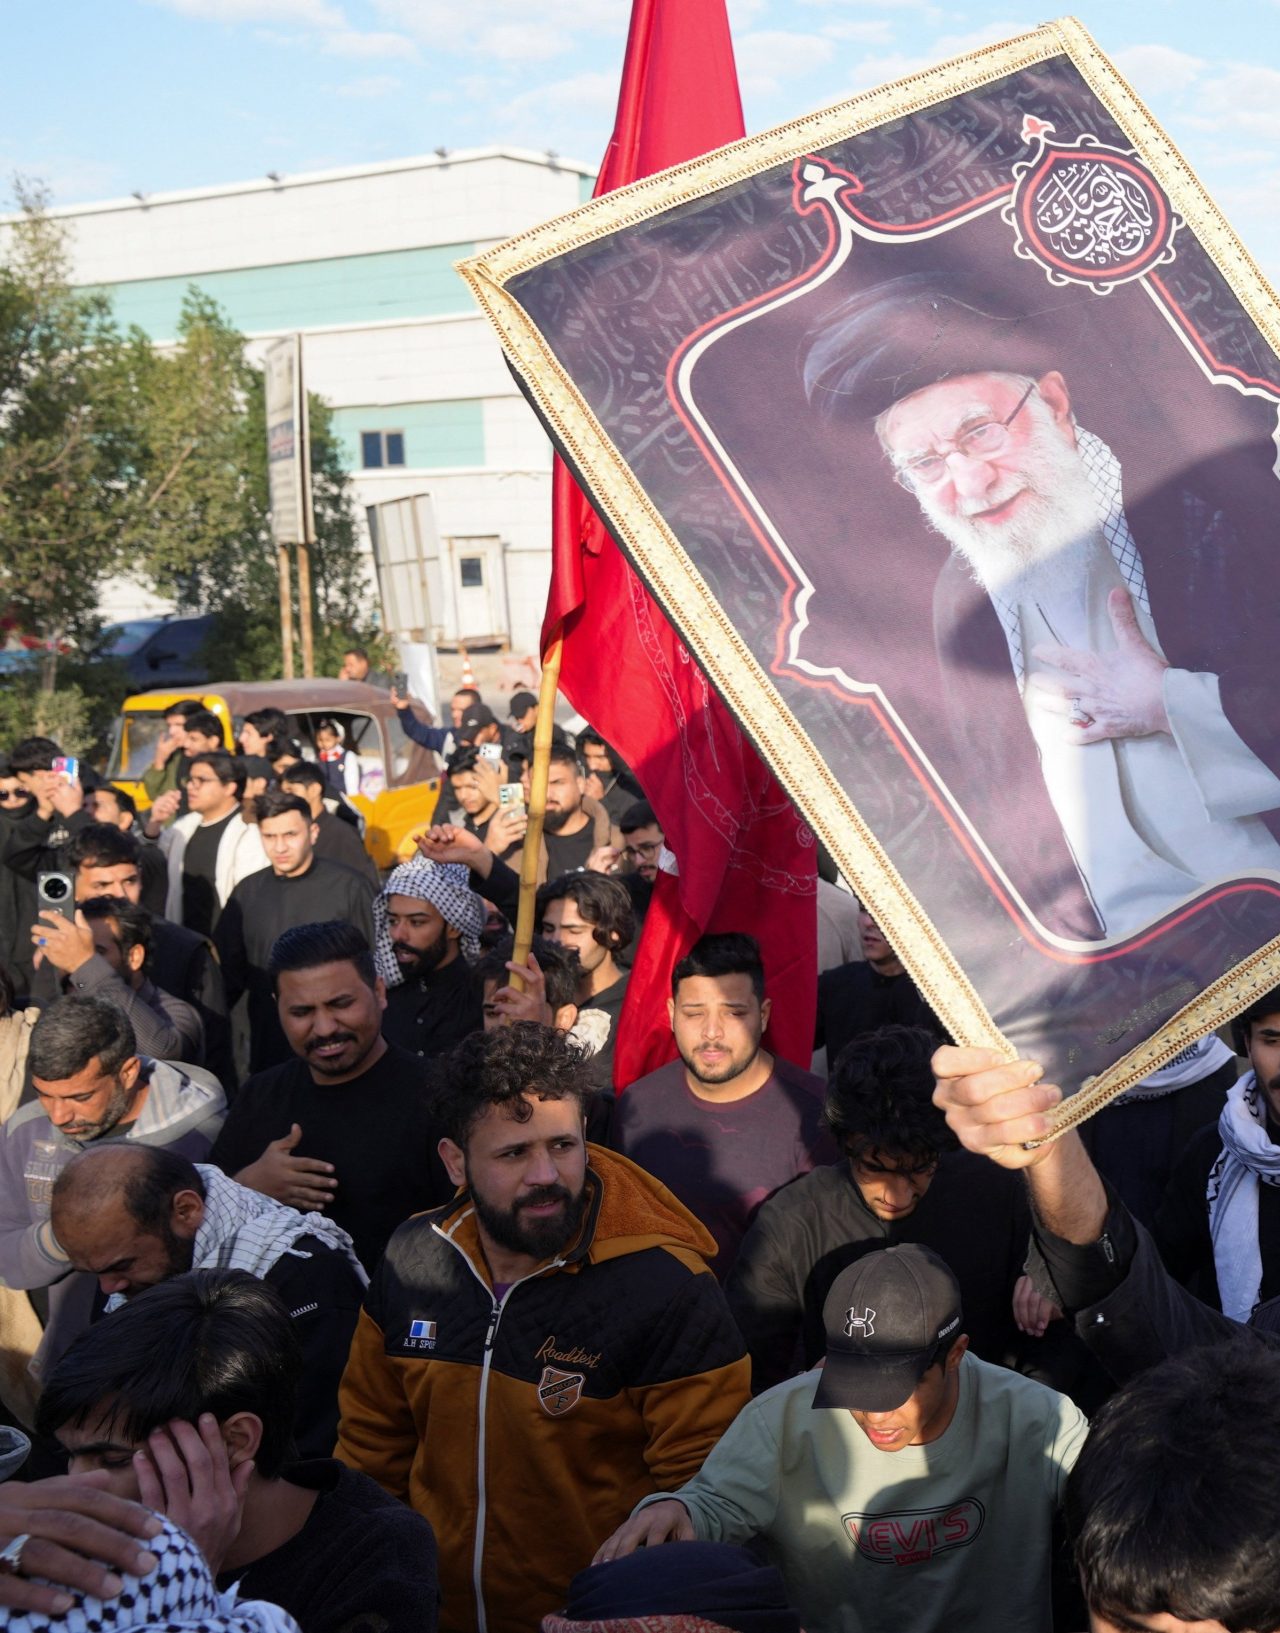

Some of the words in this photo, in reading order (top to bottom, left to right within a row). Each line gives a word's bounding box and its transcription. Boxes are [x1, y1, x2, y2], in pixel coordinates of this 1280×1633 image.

[534, 1335, 602, 1368] Roadtest
[554, 1395, 568, 1409] F
[849, 1503, 972, 1555] LEVI'S
